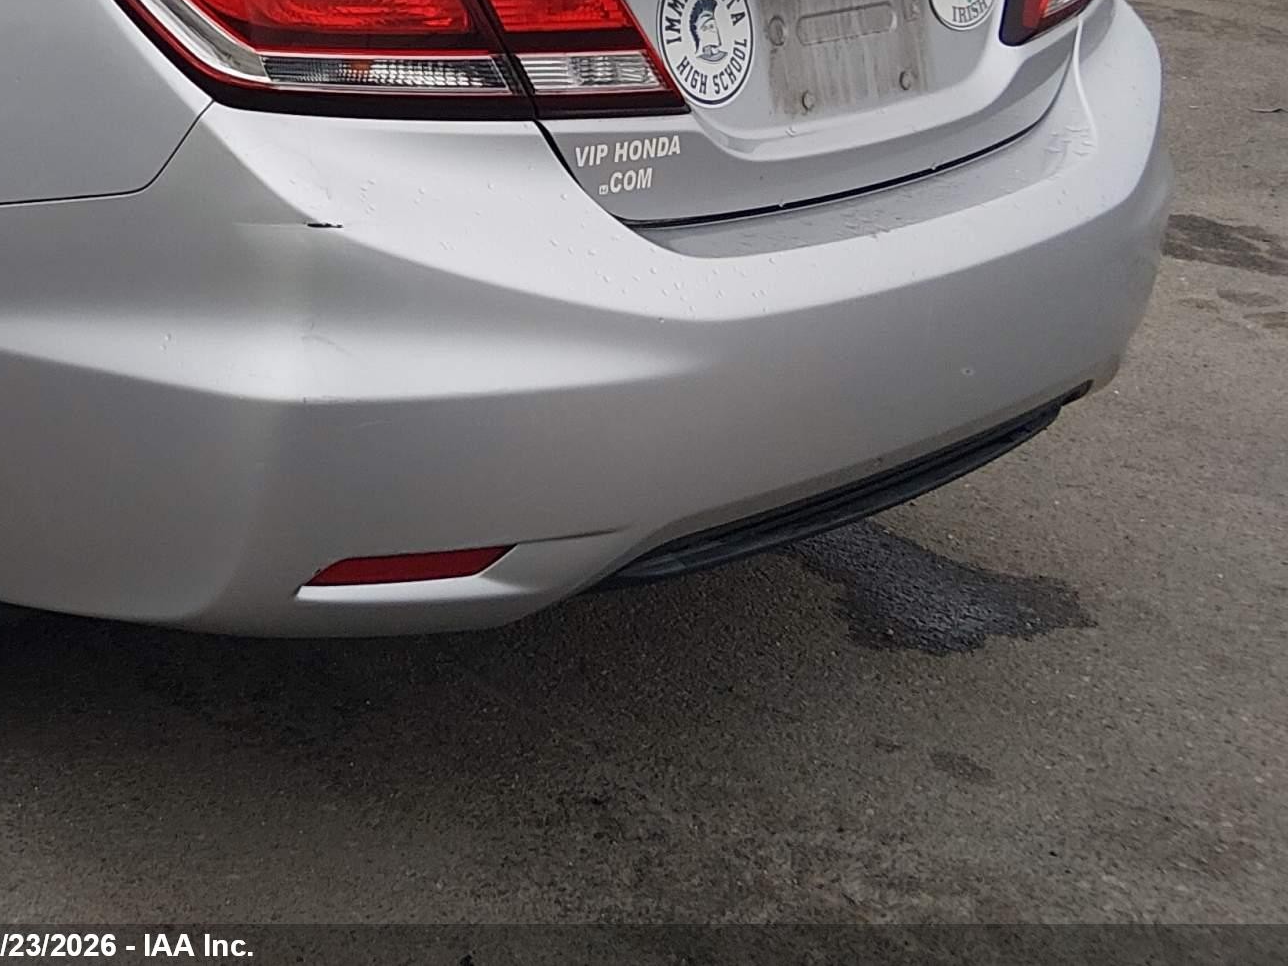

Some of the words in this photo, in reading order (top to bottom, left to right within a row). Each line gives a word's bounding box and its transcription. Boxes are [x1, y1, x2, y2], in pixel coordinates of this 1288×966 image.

[676, 55, 709, 95] HIGH
[711, 38, 748, 95] SCHOOL
[575, 144, 609, 167] VIP
[614, 135, 681, 163] HONDA
[598, 167, 653, 195] .COM
